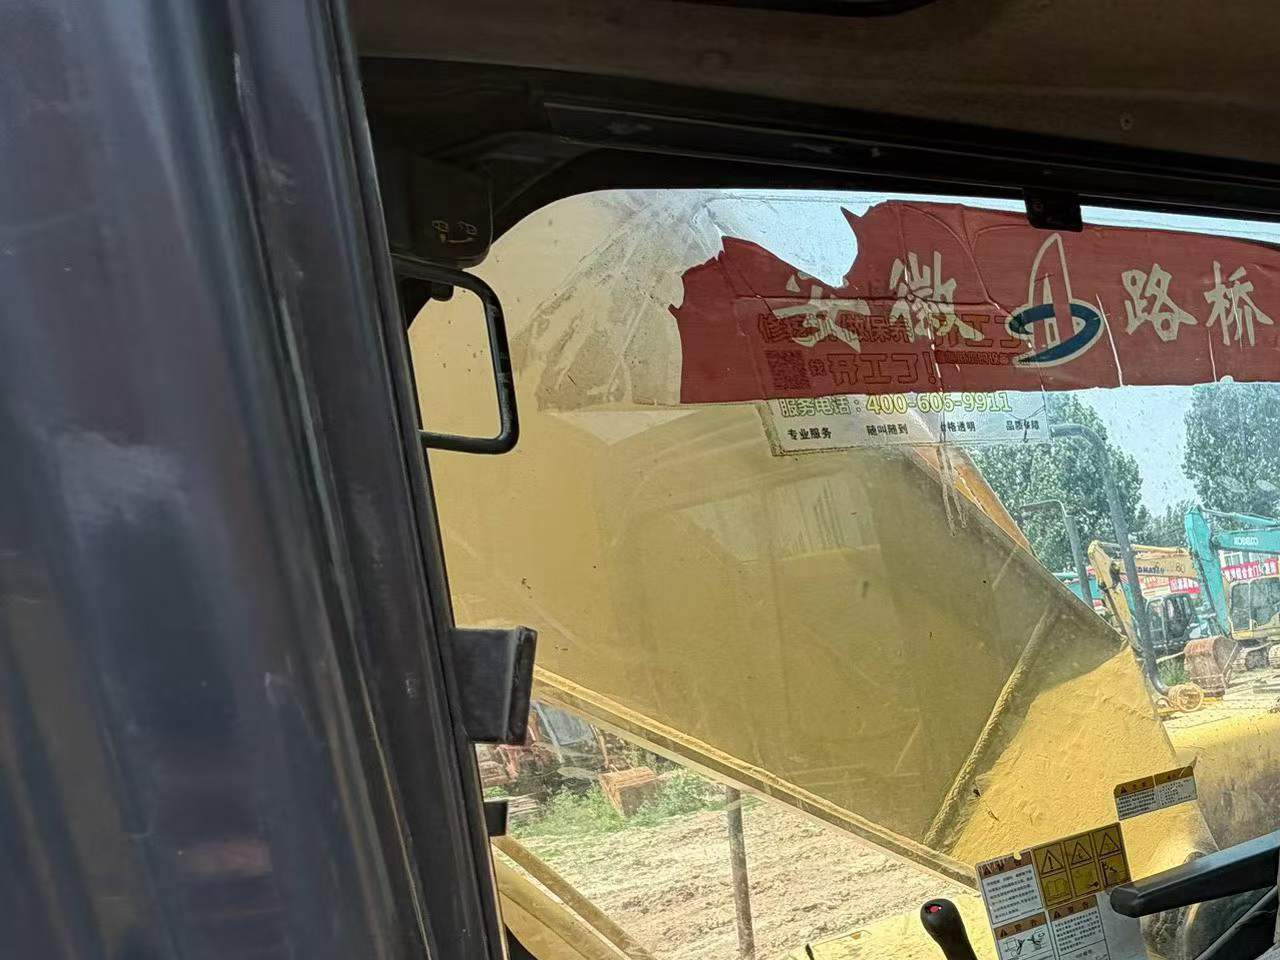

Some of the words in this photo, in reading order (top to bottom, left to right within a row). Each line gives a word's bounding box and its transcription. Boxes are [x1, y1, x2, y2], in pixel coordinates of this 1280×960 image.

[1120, 261, 1275, 347] 路桥
[787, 427, 833, 441] 专业服务
[865, 422, 909, 437] 随叫随到
